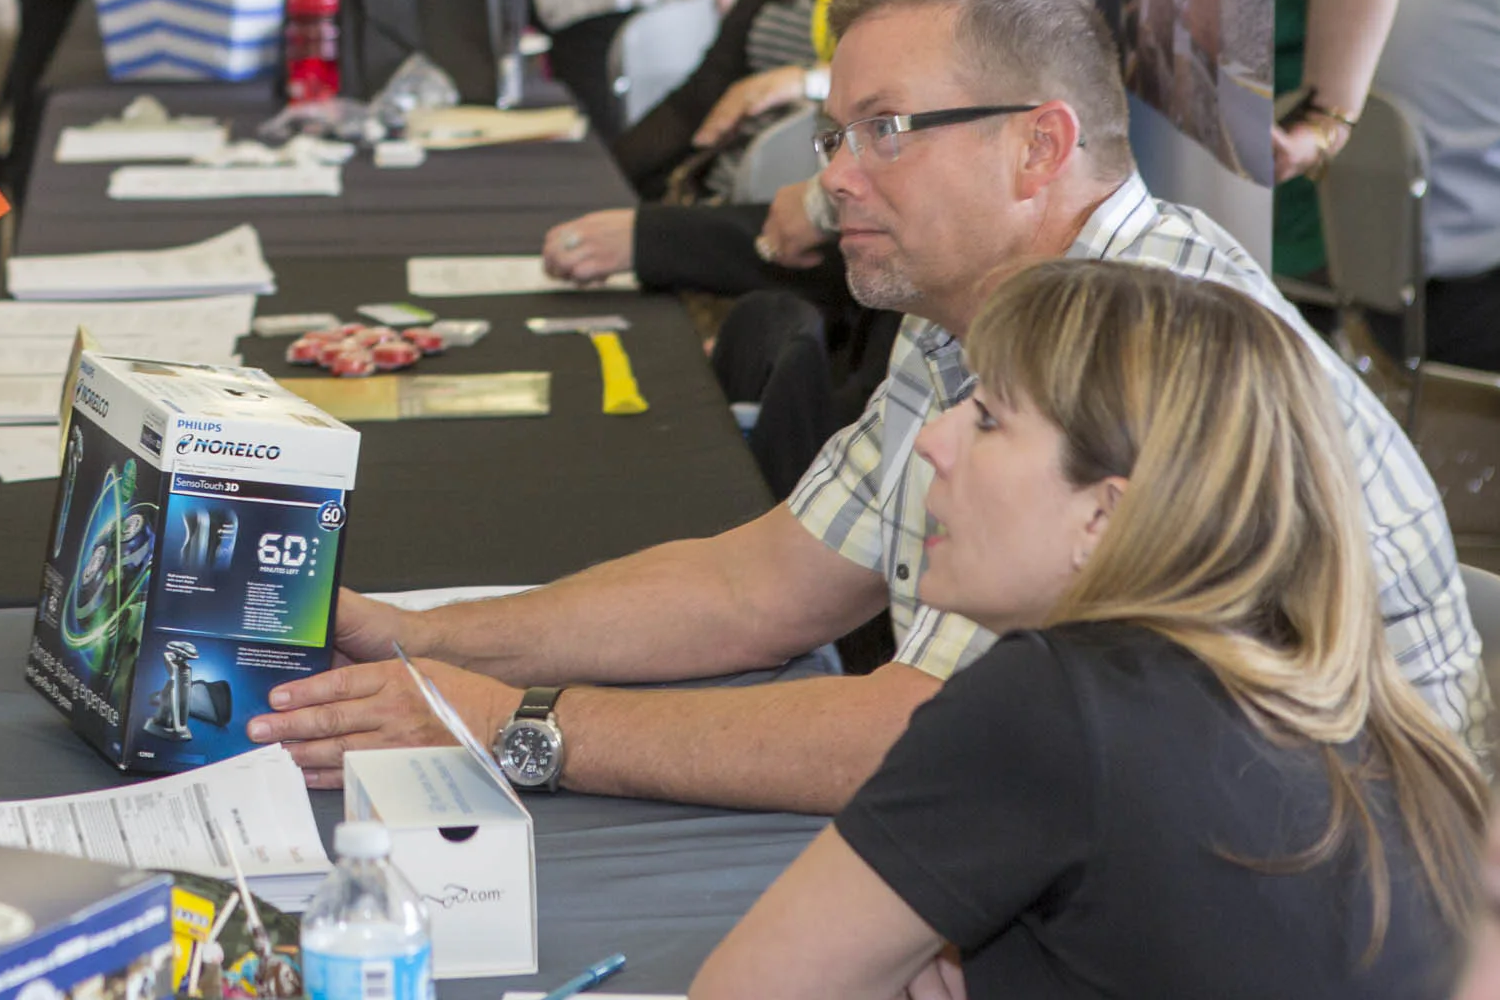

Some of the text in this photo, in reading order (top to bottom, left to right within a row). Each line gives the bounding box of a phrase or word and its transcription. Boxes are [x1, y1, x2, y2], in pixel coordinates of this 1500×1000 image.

[177, 419, 222, 432] PHILIPS
[193, 437, 281, 460] NORELCO
[176, 477, 240, 492] SensoTouch 3D
[321, 507, 341, 523] 60
[467, 889, 501, 903] .com
